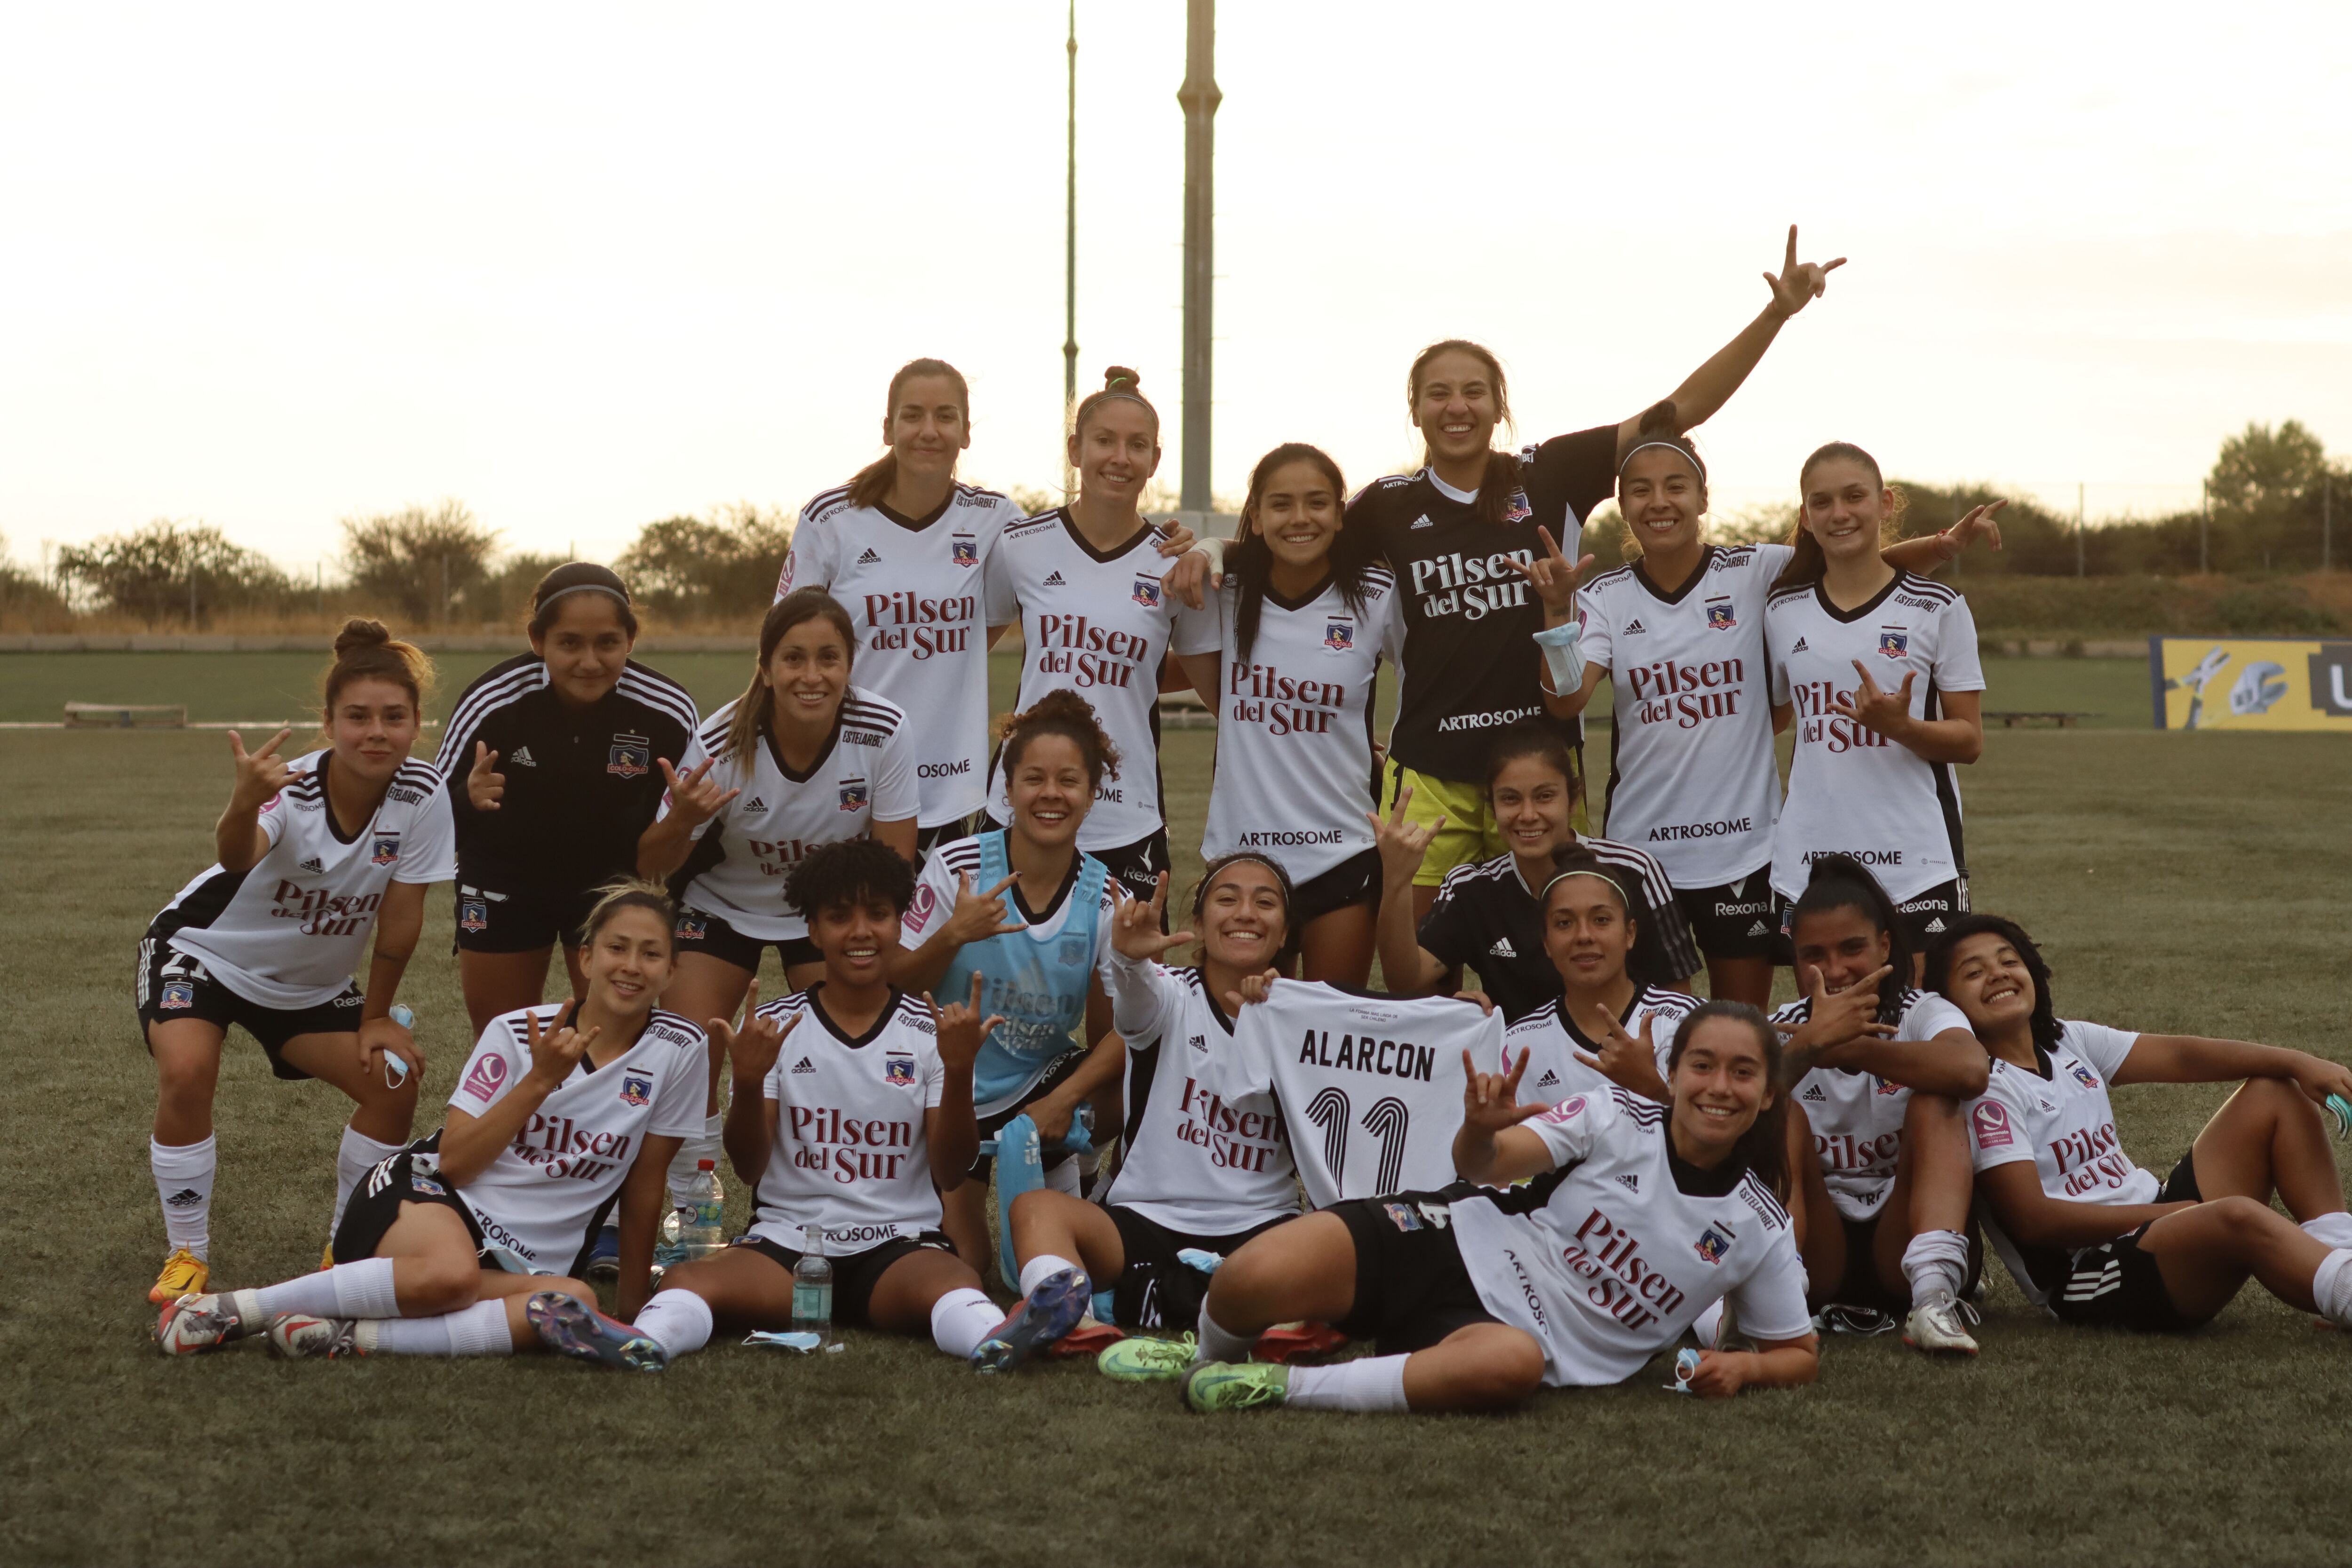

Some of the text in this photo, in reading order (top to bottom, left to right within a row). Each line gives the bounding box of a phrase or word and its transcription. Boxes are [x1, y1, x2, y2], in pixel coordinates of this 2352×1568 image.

[1383, 471, 1426, 489] ARTROOME
[819, 501, 857, 525] ARTROSOM
[1411, 520, 1433, 529] adidas
[1506, 509, 1529, 518] OLO-COLO
[1009, 523, 1057, 540] ARTROSOME
[1410, 548, 1533, 596] Pilsen
[863, 591, 975, 627] Pilsen
[1133, 596, 1157, 606] COLO-COLO
[1424, 589, 1462, 618] del
[1463, 579, 1532, 620] Sur
[1771, 592, 1810, 613] ARTROSOME
[1894, 593, 1940, 613] ESTELARBET
[872, 626, 971, 661] del Sur
[1038, 614, 1149, 662] Pilsen
[1623, 628, 1646, 637] adidas
[1792, 645, 1808, 654] adidas
[1040, 651, 1136, 688] del Sur
[1627, 658, 1744, 701] Pilsen
[1230, 662, 1345, 707] Pilsen
[1641, 688, 1742, 729] del Sur
[1793, 681, 1896, 718] Pils
[1233, 700, 1338, 735] del Sur
[842, 731, 886, 748] ESTELARBET
[1804, 719, 1825, 744] del
[510, 755, 536, 767] adidas
[918, 759, 970, 778] OSOME
[840, 801, 867, 811] COLO-COLO
[1239, 830, 1343, 846] ARTROSOME
[1649, 817, 1752, 842] ARTROSOME
[747, 838, 823, 864] Pils
[1801, 851, 1902, 867] ARSOME
[300, 863, 323, 874] adidas
[1124, 866, 1159, 886] Rexo
[271, 879, 381, 916] Pilsen
[1716, 901, 1768, 916] Rexona
[300, 909, 368, 937] Sur
[1490, 947, 1517, 958] adidas
[333, 995, 366, 1008] Rexo
[898, 1013, 937, 1036] ESTELARBE
[1505, 1019, 1552, 1038] ARTROSOME
[1299, 1029, 1436, 1082] ALARCON
[1537, 1078, 1560, 1088] adidas
[620, 1093, 648, 1106] COLO-COLO
[1803, 1092, 1827, 1102] adidas
[513, 1113, 631, 1160] Pilsen
[788, 1106, 912, 1148] Pilsen
[1979, 1130, 2009, 1138] Campeonato
[1177, 1119, 1275, 1172] del Sur
[1304, 1086, 1409, 1199] 11
[2047, 1122, 2116, 1177] Pilse
[795, 1146, 906, 1184] del Sur
[1615, 1176, 1639, 1194] adidas
[2065, 1166, 2102, 1197] del
[167, 1193, 202, 1207] adidas
[1739, 1187, 1776, 1231] ESTELARBET
[475, 1208, 537, 1261] TROSOME
[825, 1225, 899, 1242] ROSOME
[1573, 1206, 1685, 1316] Pilsen
[1694, 1242, 1720, 1266] COLO-COLO
[1563, 1245, 1661, 1333] del Sur
